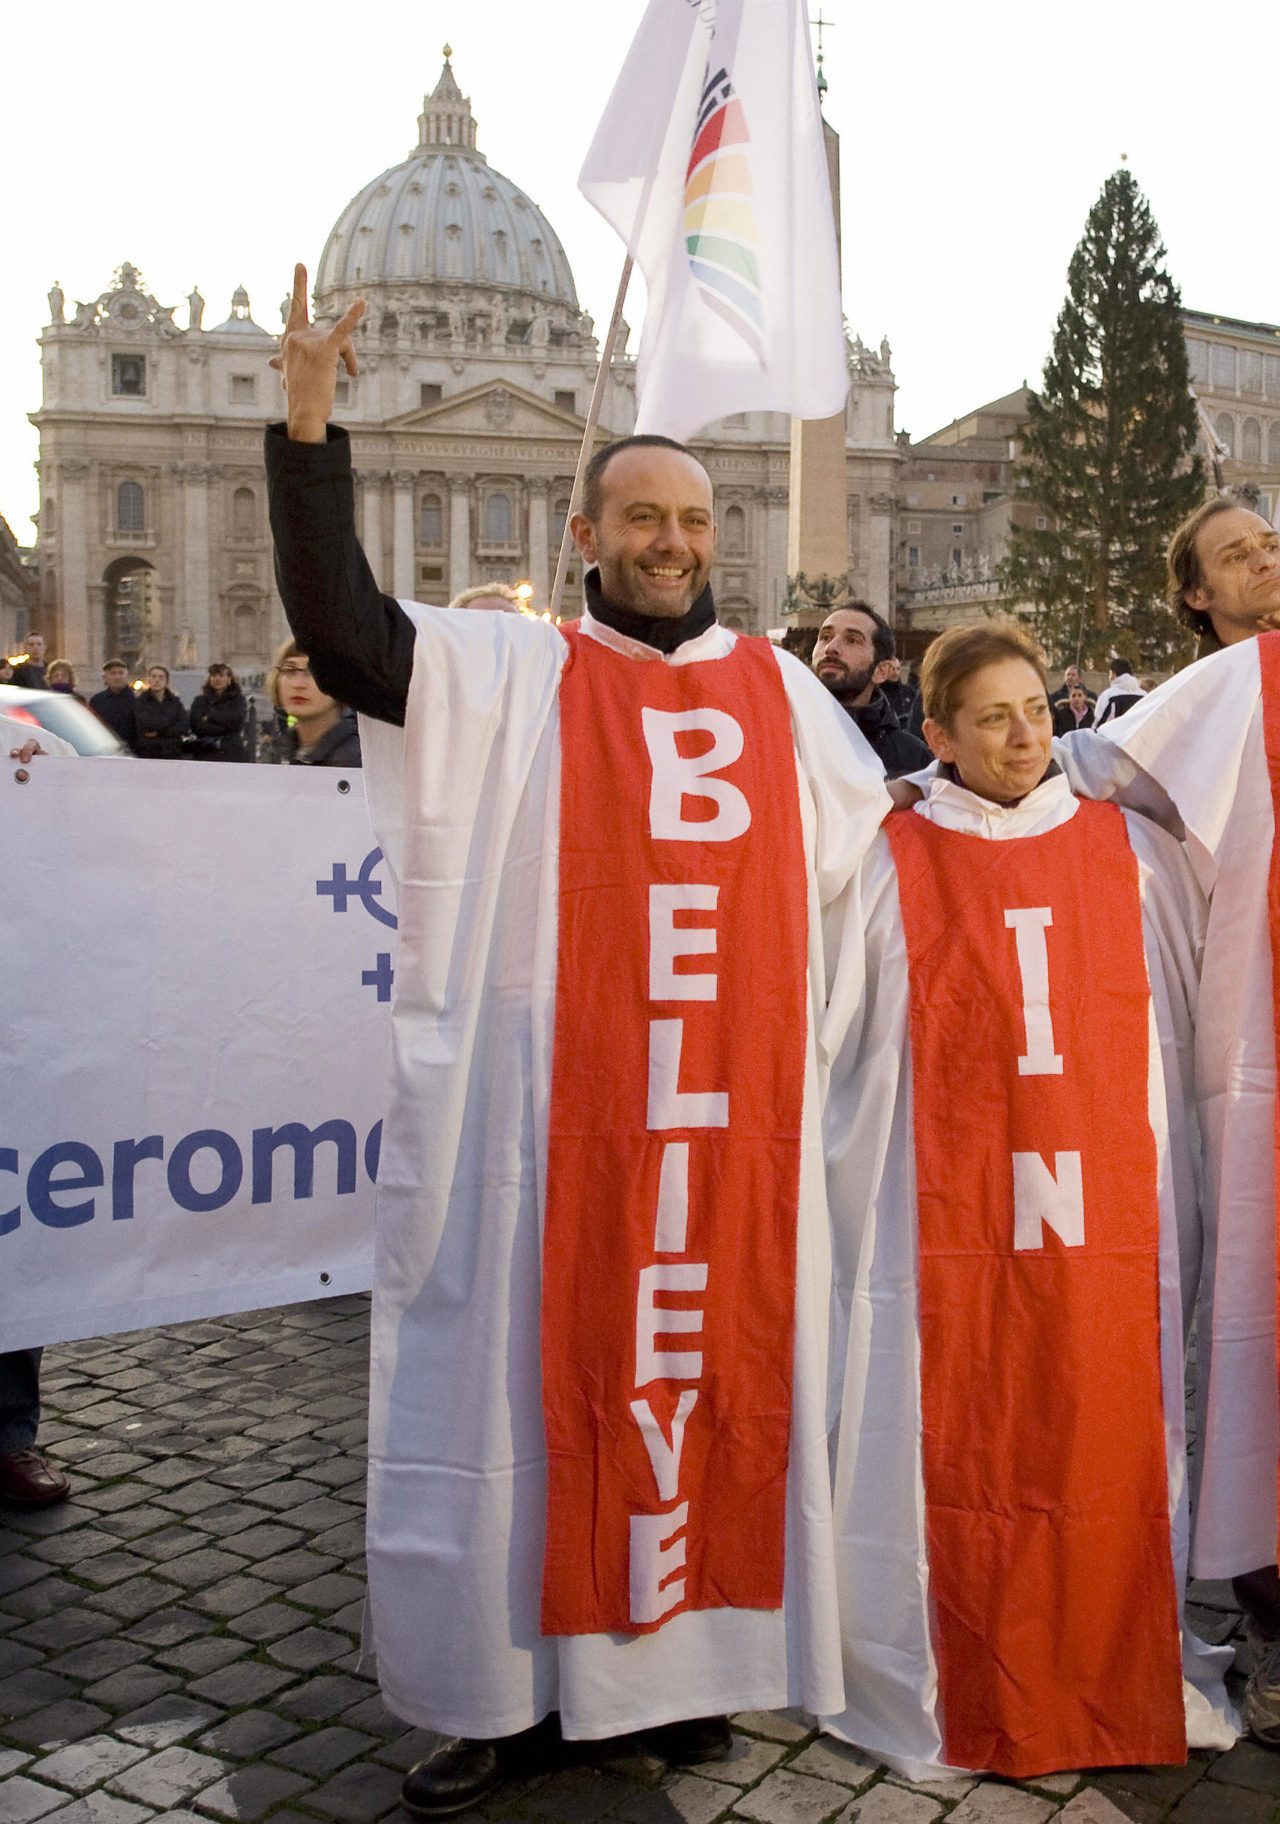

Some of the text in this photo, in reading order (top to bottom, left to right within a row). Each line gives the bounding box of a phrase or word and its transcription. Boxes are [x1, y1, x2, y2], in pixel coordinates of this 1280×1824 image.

[0, 1118, 382, 1236] erom
[628, 706, 752, 1624] BELIEVE
[1003, 906, 1085, 1250] IN
